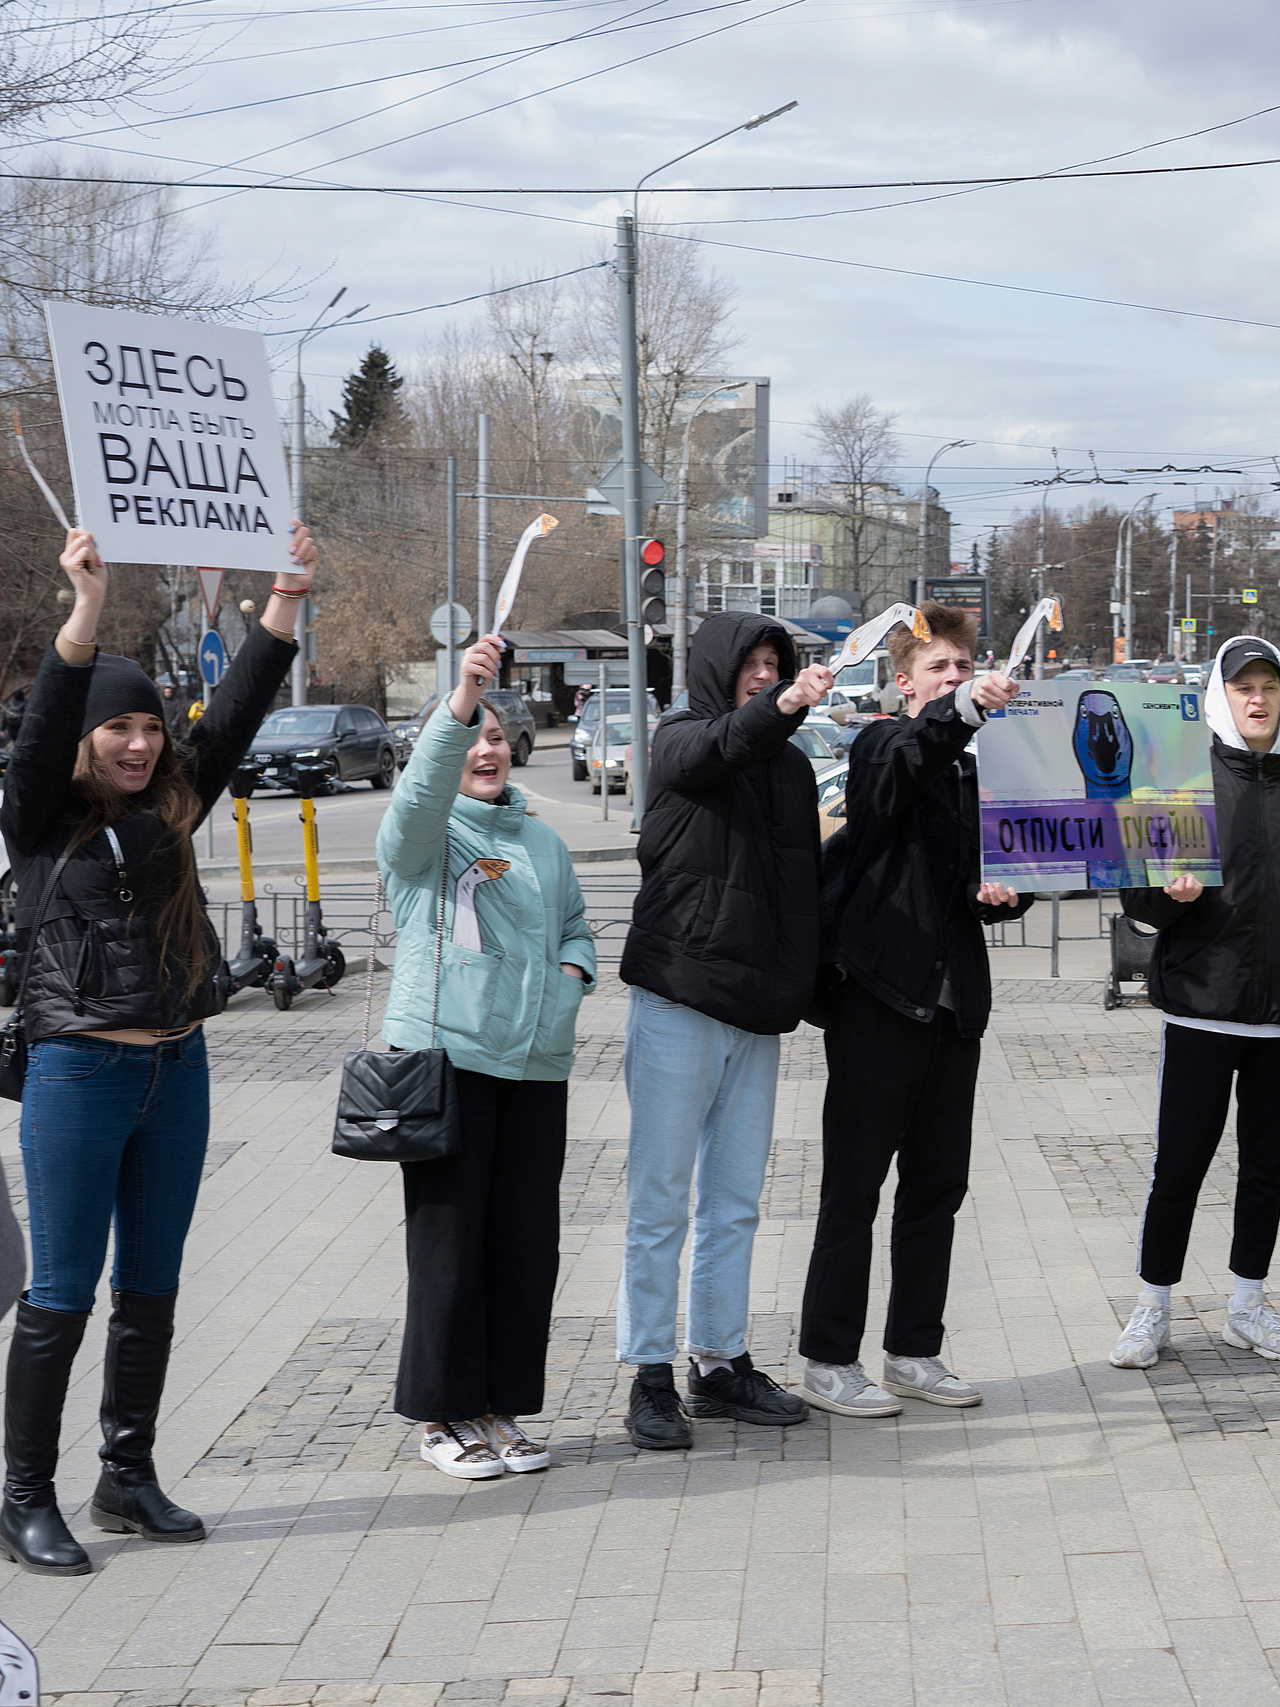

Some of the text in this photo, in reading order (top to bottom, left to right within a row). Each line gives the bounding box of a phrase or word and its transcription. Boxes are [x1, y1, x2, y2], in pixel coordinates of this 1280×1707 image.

[84, 341, 248, 402] ЗДЕСЬ
[93, 401, 256, 440] МОГЛА БЫТЬ
[98, 432, 270, 498] ВАША
[108, 493, 275, 535] РЕКЛАМА
[1007, 708, 1039, 716] ПЕЧАТИ
[998, 810, 1206, 853] ОТПУСТИ ГУСЕЙ!!!
